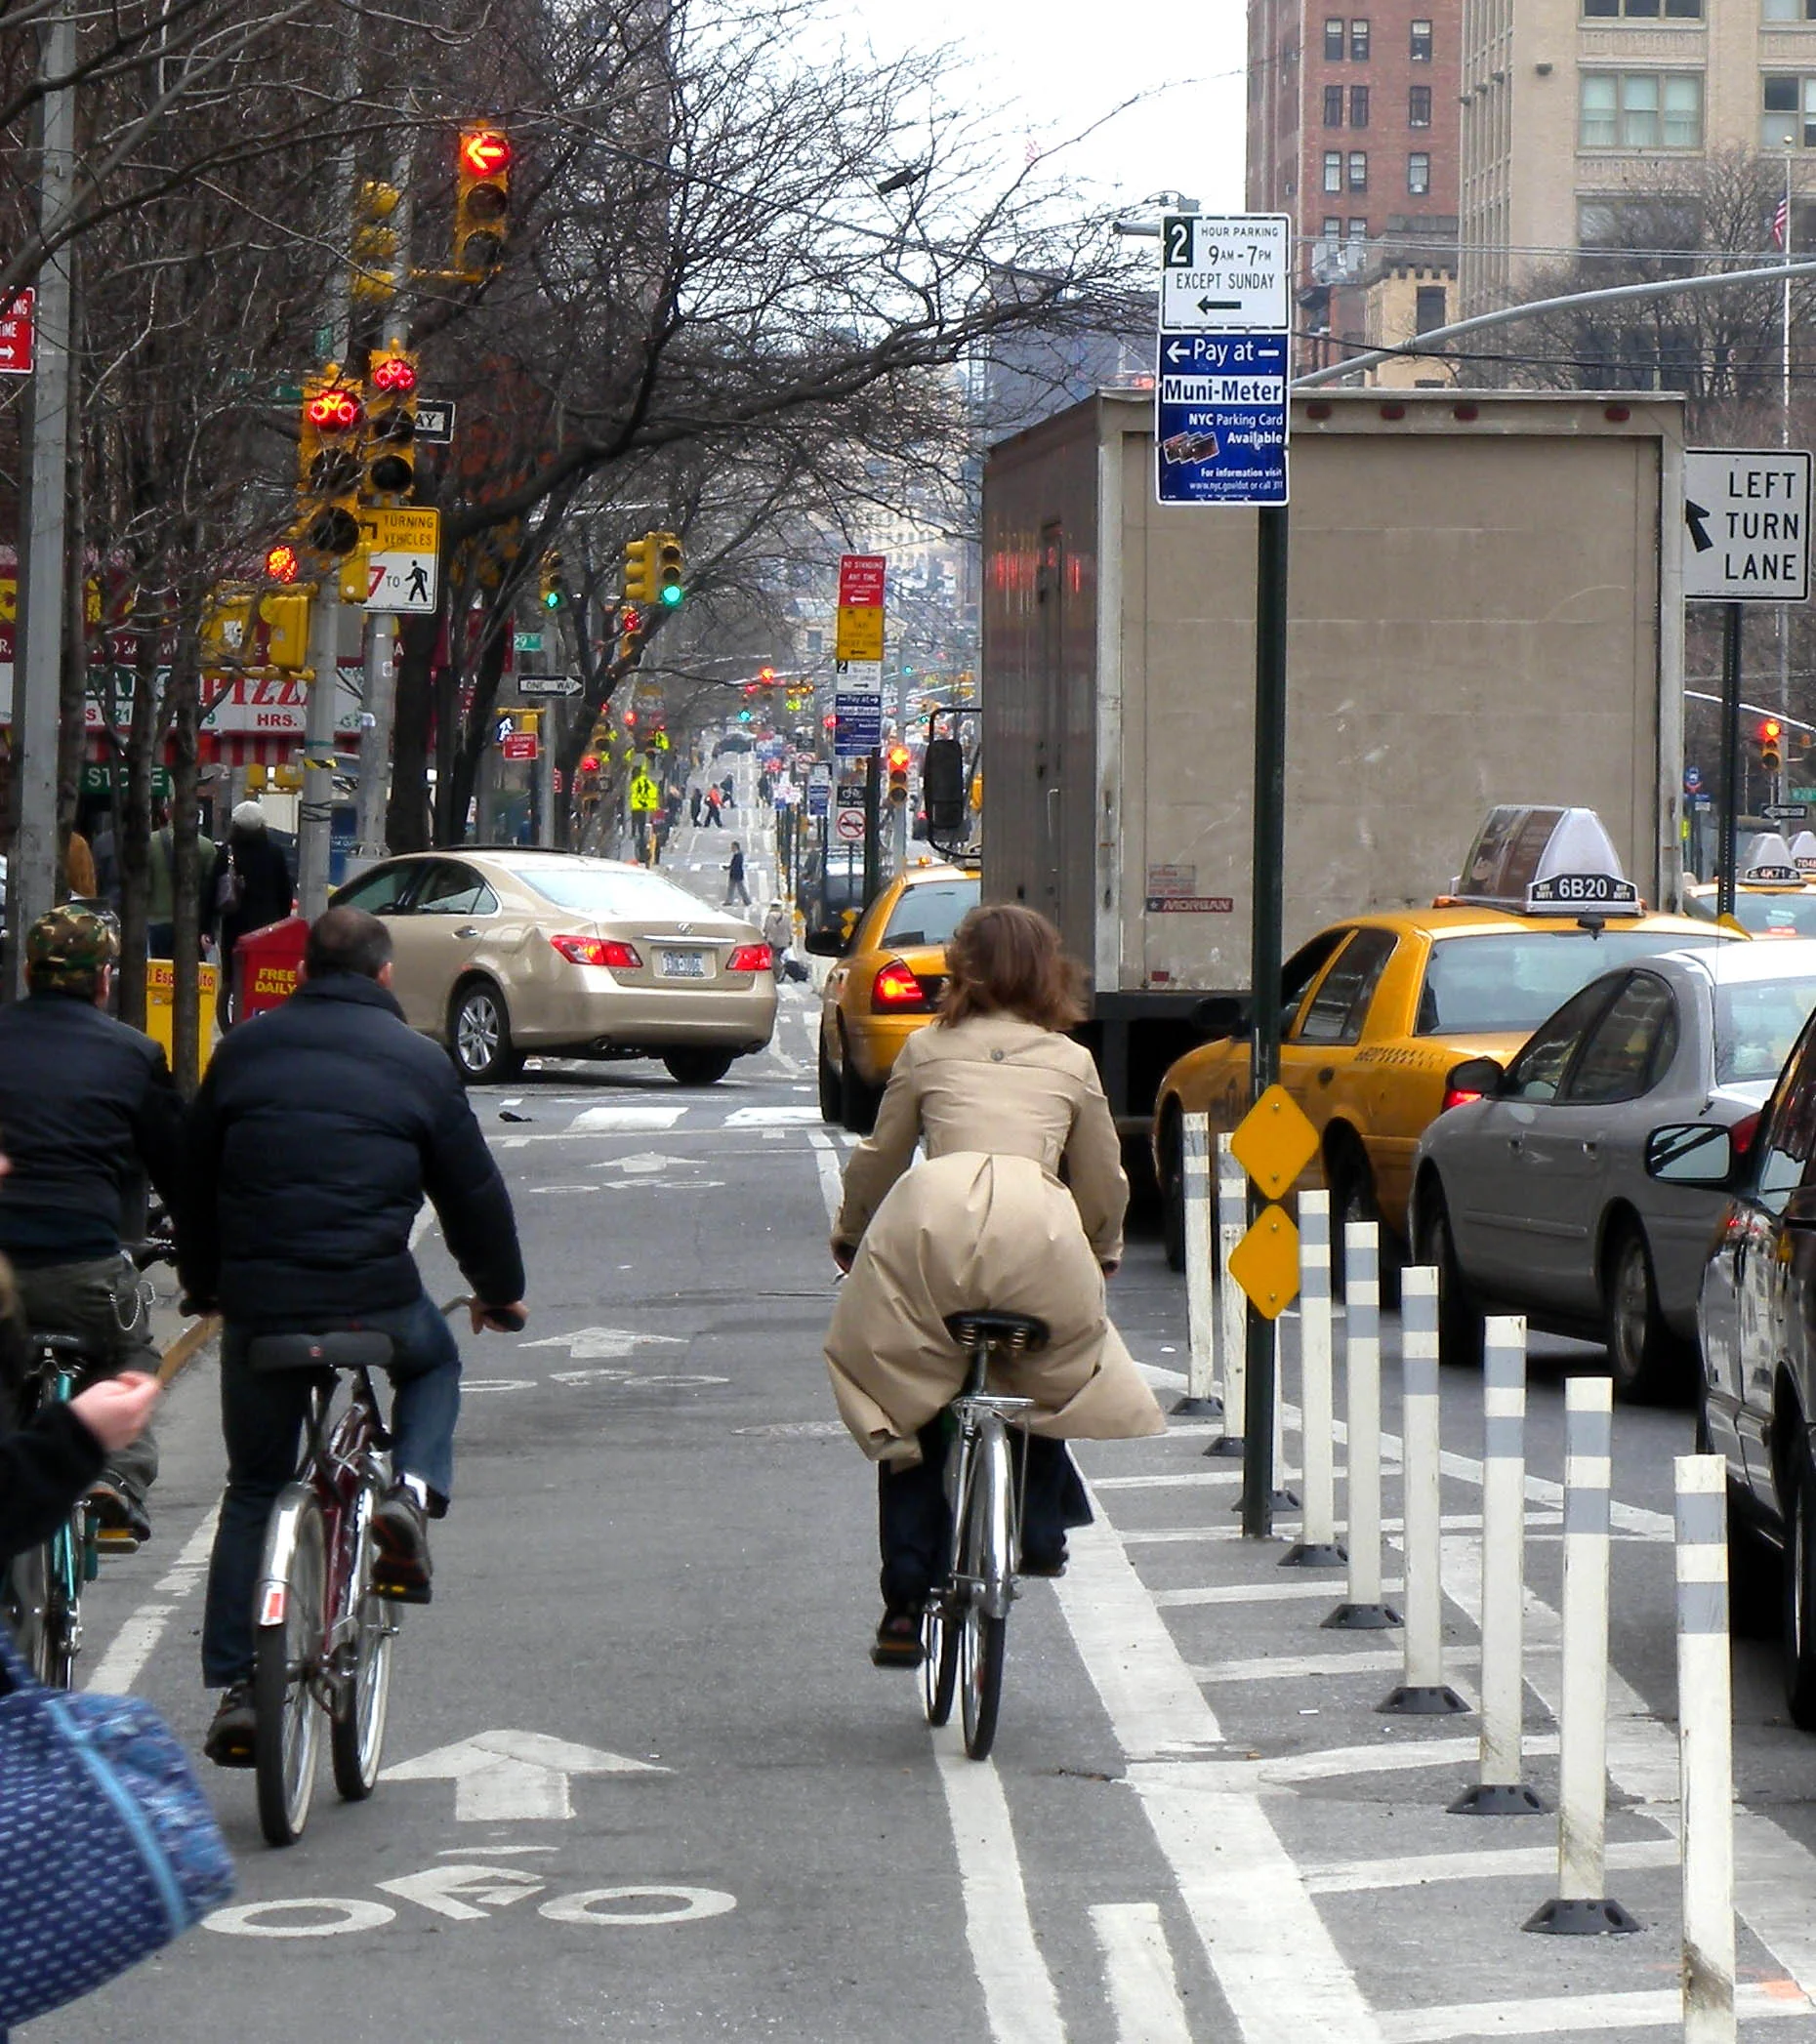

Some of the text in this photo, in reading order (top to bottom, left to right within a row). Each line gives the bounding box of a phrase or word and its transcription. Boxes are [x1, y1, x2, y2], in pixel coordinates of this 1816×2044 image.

[1201, 226, 1278, 237] HOUR PARKING
[1171, 224, 1188, 264] 2
[1176, 272, 1274, 290] EXCEPT SUNDAY
[1193, 338, 1254, 367] Pay at
[1165, 379, 1281, 401] Muni-Meter
[1188, 413, 1284, 429] NYC Parking Card
[1227, 430, 1283, 444] Available
[1201, 468, 1282, 477] For information visit
[1729, 471, 1796, 499] LEFT
[384, 515, 433, 529] TURNING
[1726, 512, 1798, 540] TURN
[384, 533, 433, 547] VEHICLES
[1725, 553, 1796, 580] LANE
[387, 576, 400, 588] TO
[201, 675, 308, 706] PIZZ
[526, 680, 575, 690] ONE WAY
[257, 714, 297, 726] HRS.
[1558, 878, 1608, 899] 6B20
[1163, 900, 1229, 911] MORGAN
[258, 967, 297, 983] FREE
[255, 980, 298, 996] DAILY
